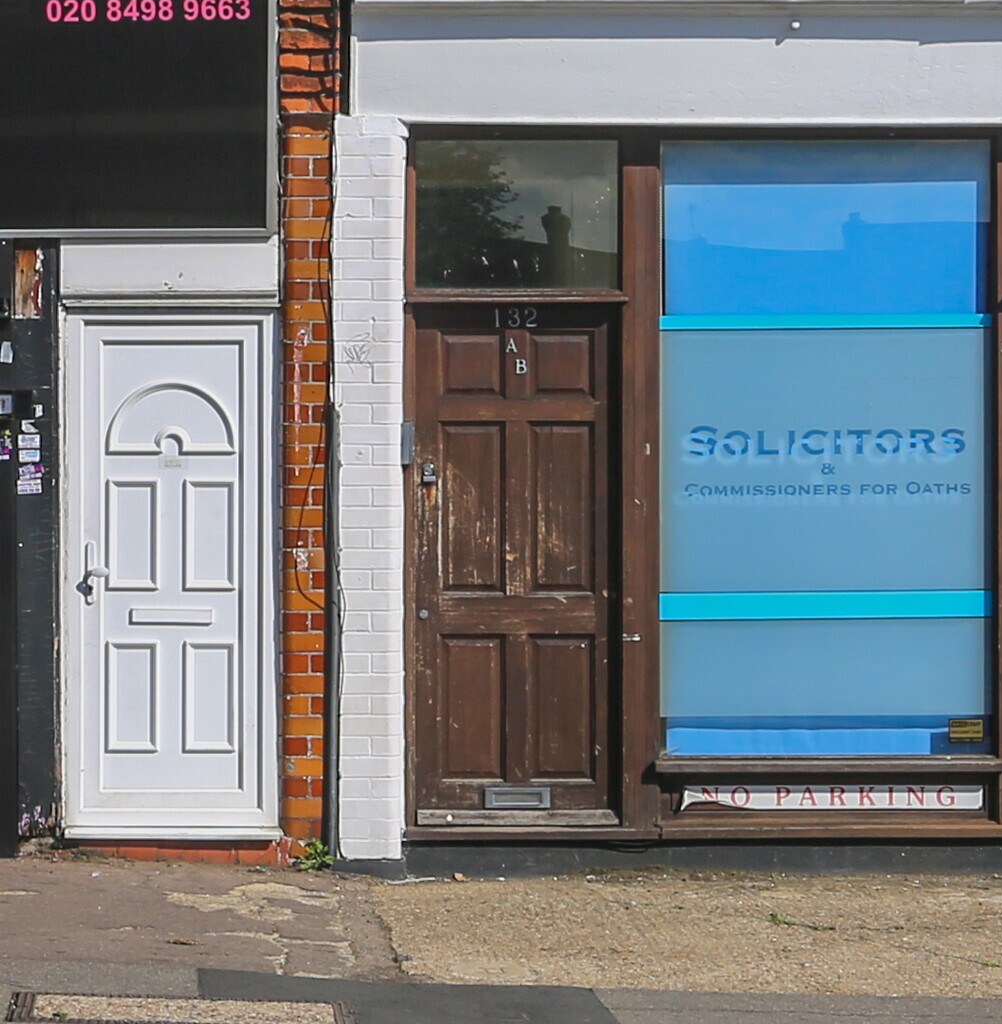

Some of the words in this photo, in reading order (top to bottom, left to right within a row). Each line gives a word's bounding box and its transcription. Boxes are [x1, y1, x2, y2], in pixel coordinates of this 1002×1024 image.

[46, 0, 97, 22] 020
[495, 307, 537, 328] 132
[505, 337, 518, 353] A
[515, 358, 528, 374] B
[688, 425, 967, 457] SOLICITORS
[821, 463, 836, 475] &
[684, 483, 852, 497] COMMISSIONERS
[860, 483, 898, 495] FOR
[905, 481, 972, 495] OATHS
[701, 786, 752, 807] NO
[775, 786, 957, 807] PARKING
